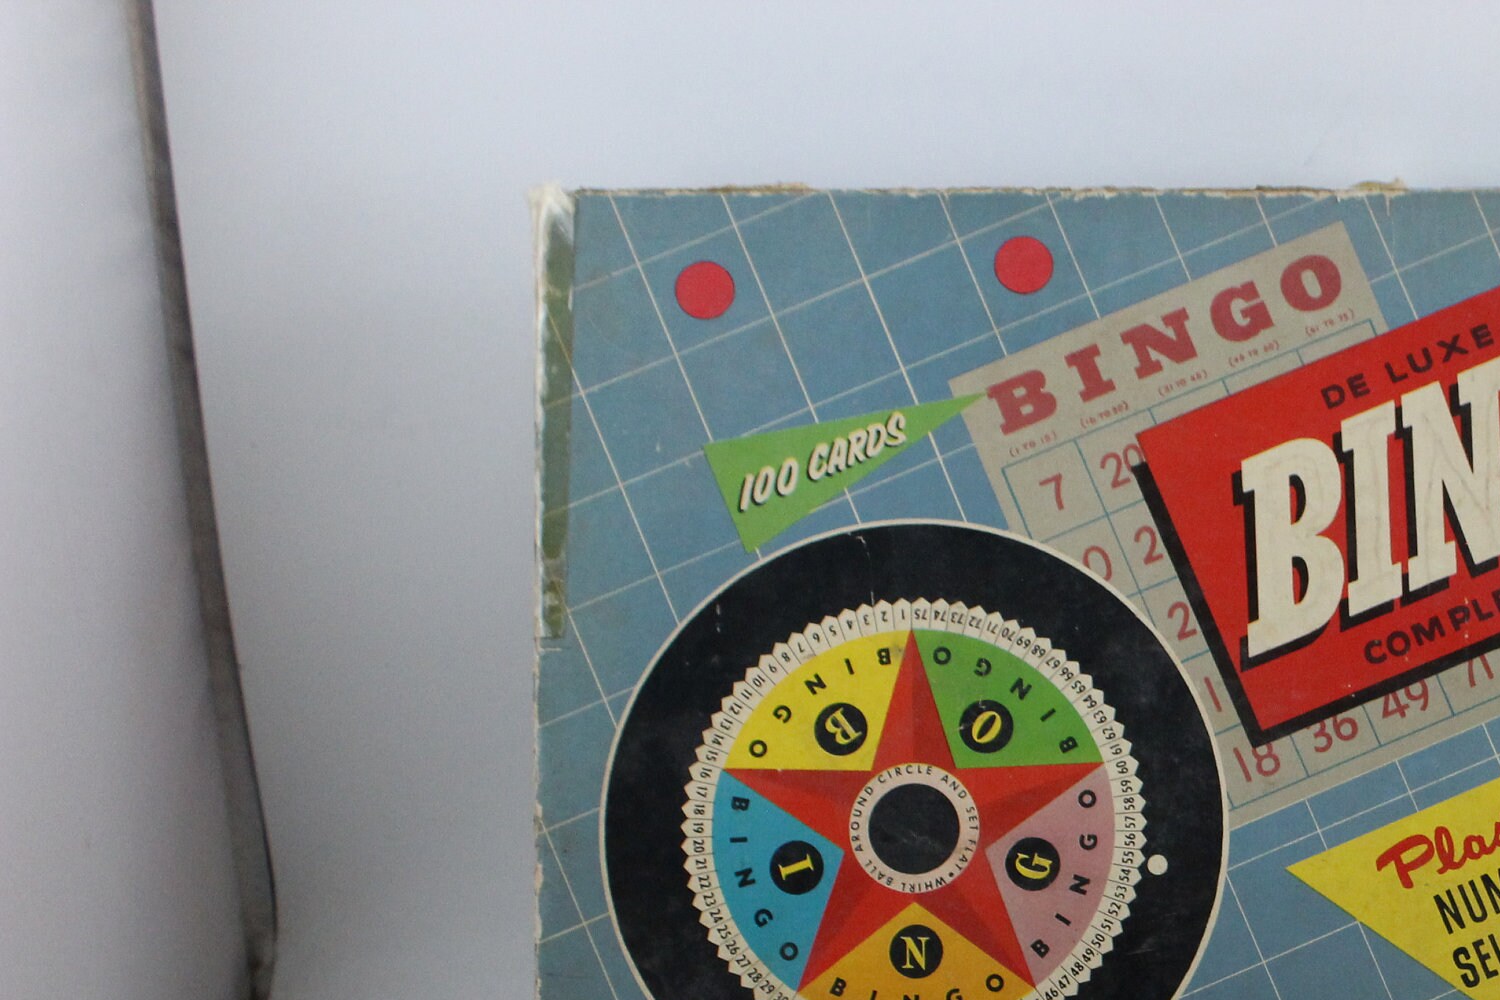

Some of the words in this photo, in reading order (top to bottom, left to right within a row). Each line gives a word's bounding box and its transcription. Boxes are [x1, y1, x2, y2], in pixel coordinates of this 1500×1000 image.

[986, 254, 1342, 436] BINGO
[1320, 374, 1372, 410] DE
[1387, 323, 1496, 385] LUXE
[738, 457, 800, 514] 100
[806, 410, 908, 482] CARDS
[1039, 472, 1065, 511] 7
[877, 764, 933, 784] CIRCLE
[1233, 741, 1281, 783] 18
[940, 774, 967, 799] AND
[850, 786, 874, 852] AROUND
[965, 806, 979, 831] SET
[955, 839, 977, 871] FLAT
[865, 859, 894, 886] BALL
[901, 876, 947, 893] WHIRL
[900, 936, 930, 971] N
[1070, 961, 1085, 977] 48
[1057, 974, 1071, 990] 47
